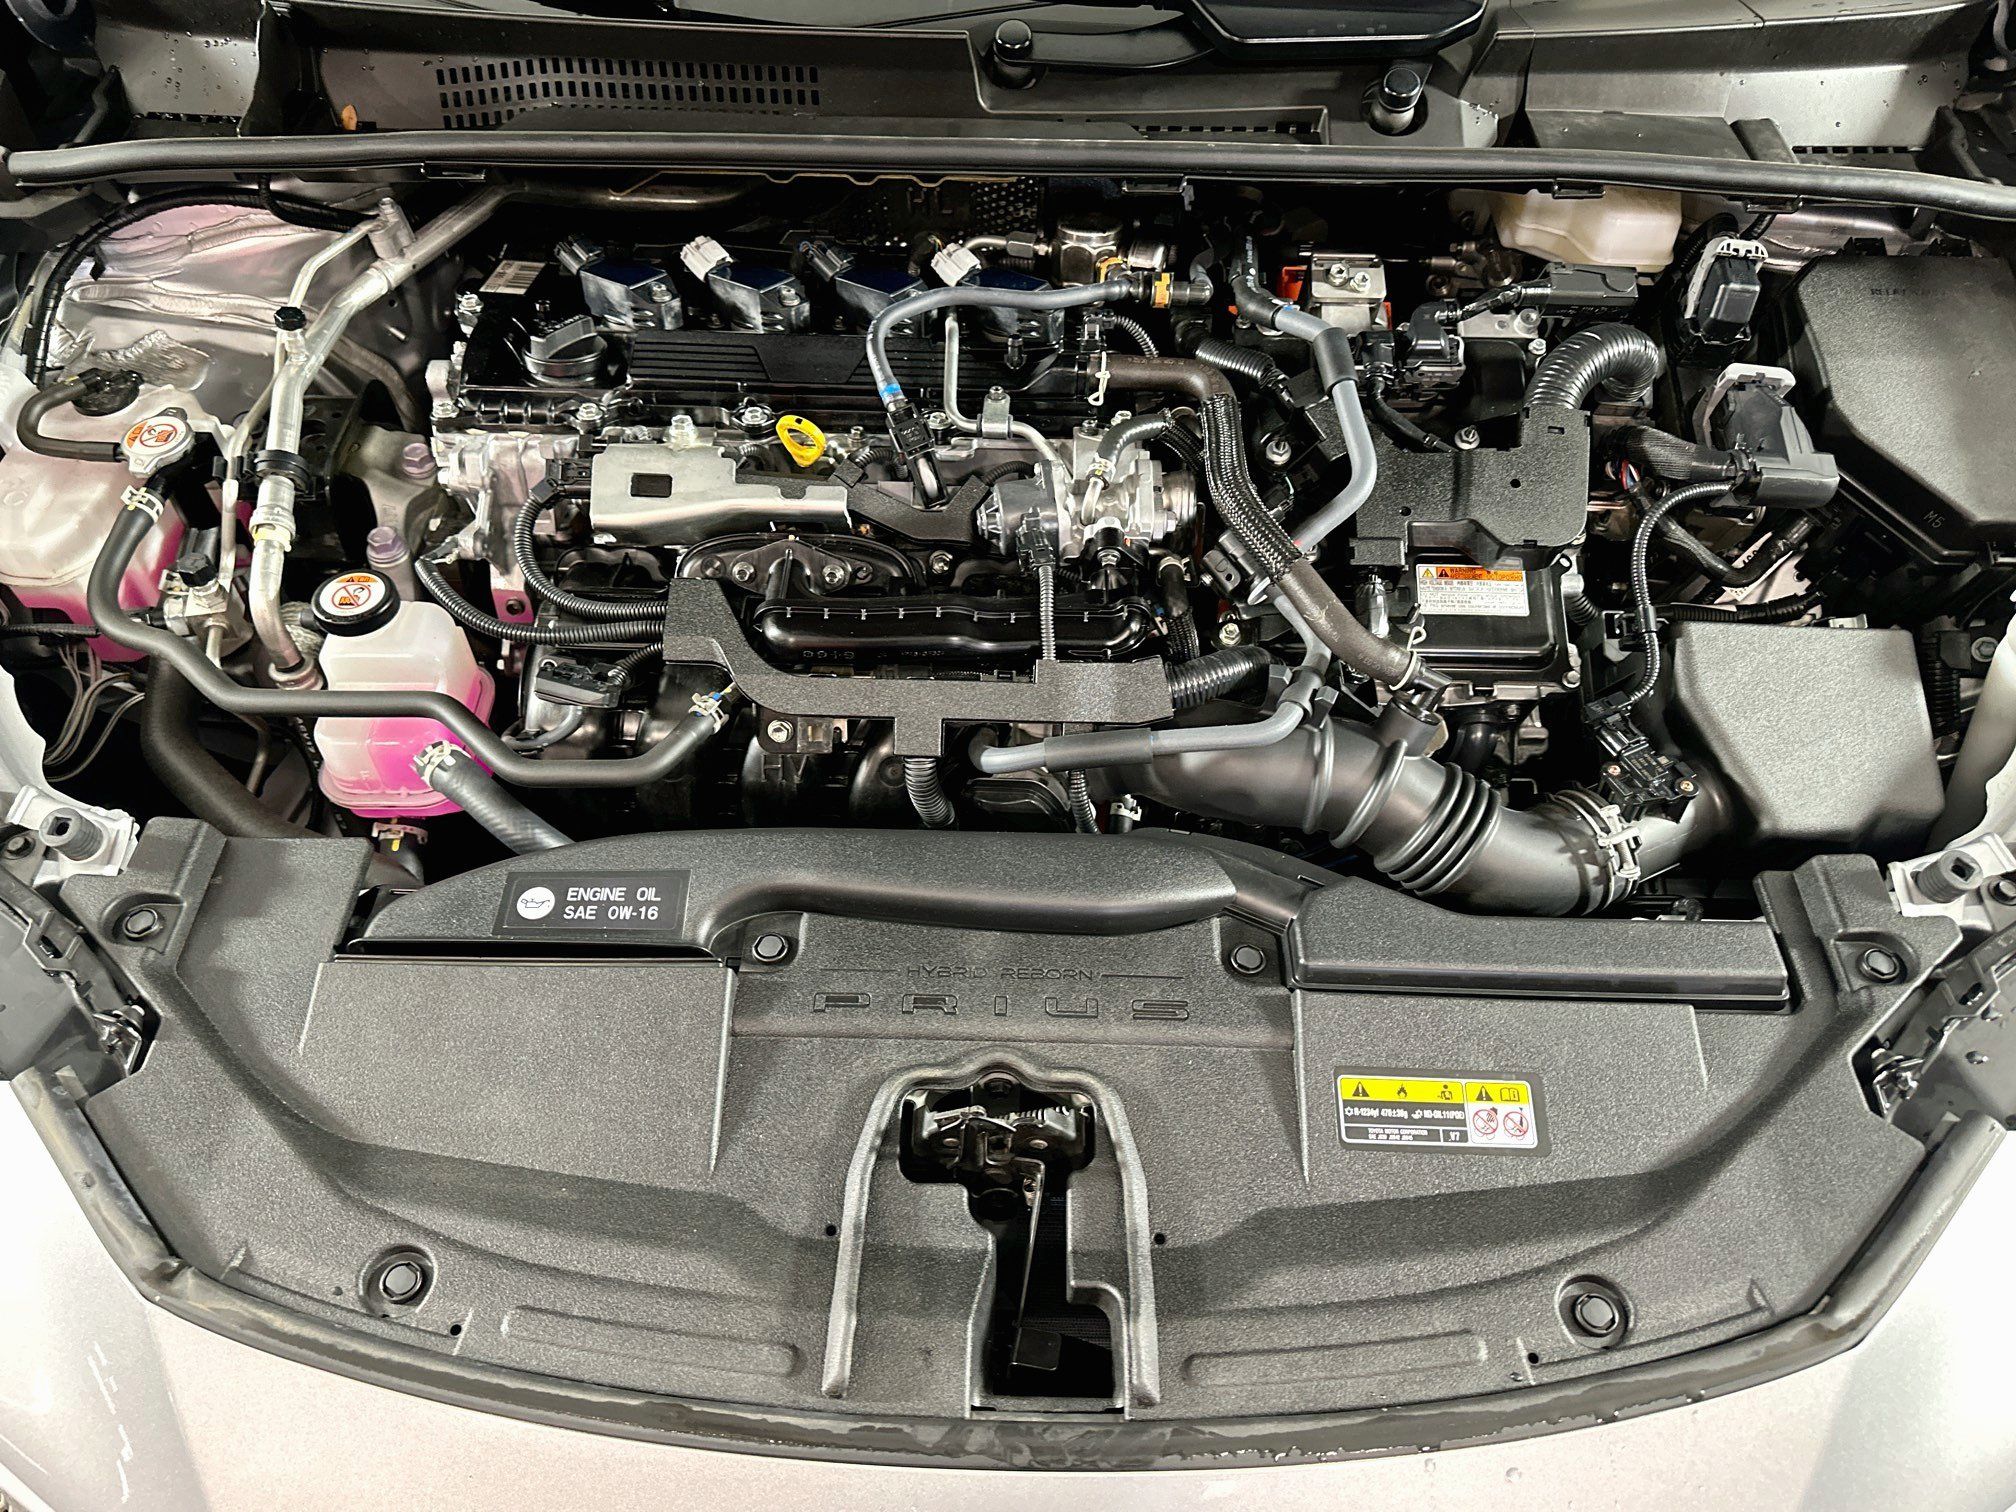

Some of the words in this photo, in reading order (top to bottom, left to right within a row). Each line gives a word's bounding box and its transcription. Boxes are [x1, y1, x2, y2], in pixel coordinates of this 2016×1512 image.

[566, 887, 627, 902] ENGINE
[636, 887, 661, 901] OIL
[563, 906, 597, 920] SAE
[607, 906, 659, 920] 0W-16
[907, 965, 988, 979] HYBRID
[1000, 967, 1094, 981] REBORN
[813, 992, 1189, 1021] PRIUS
